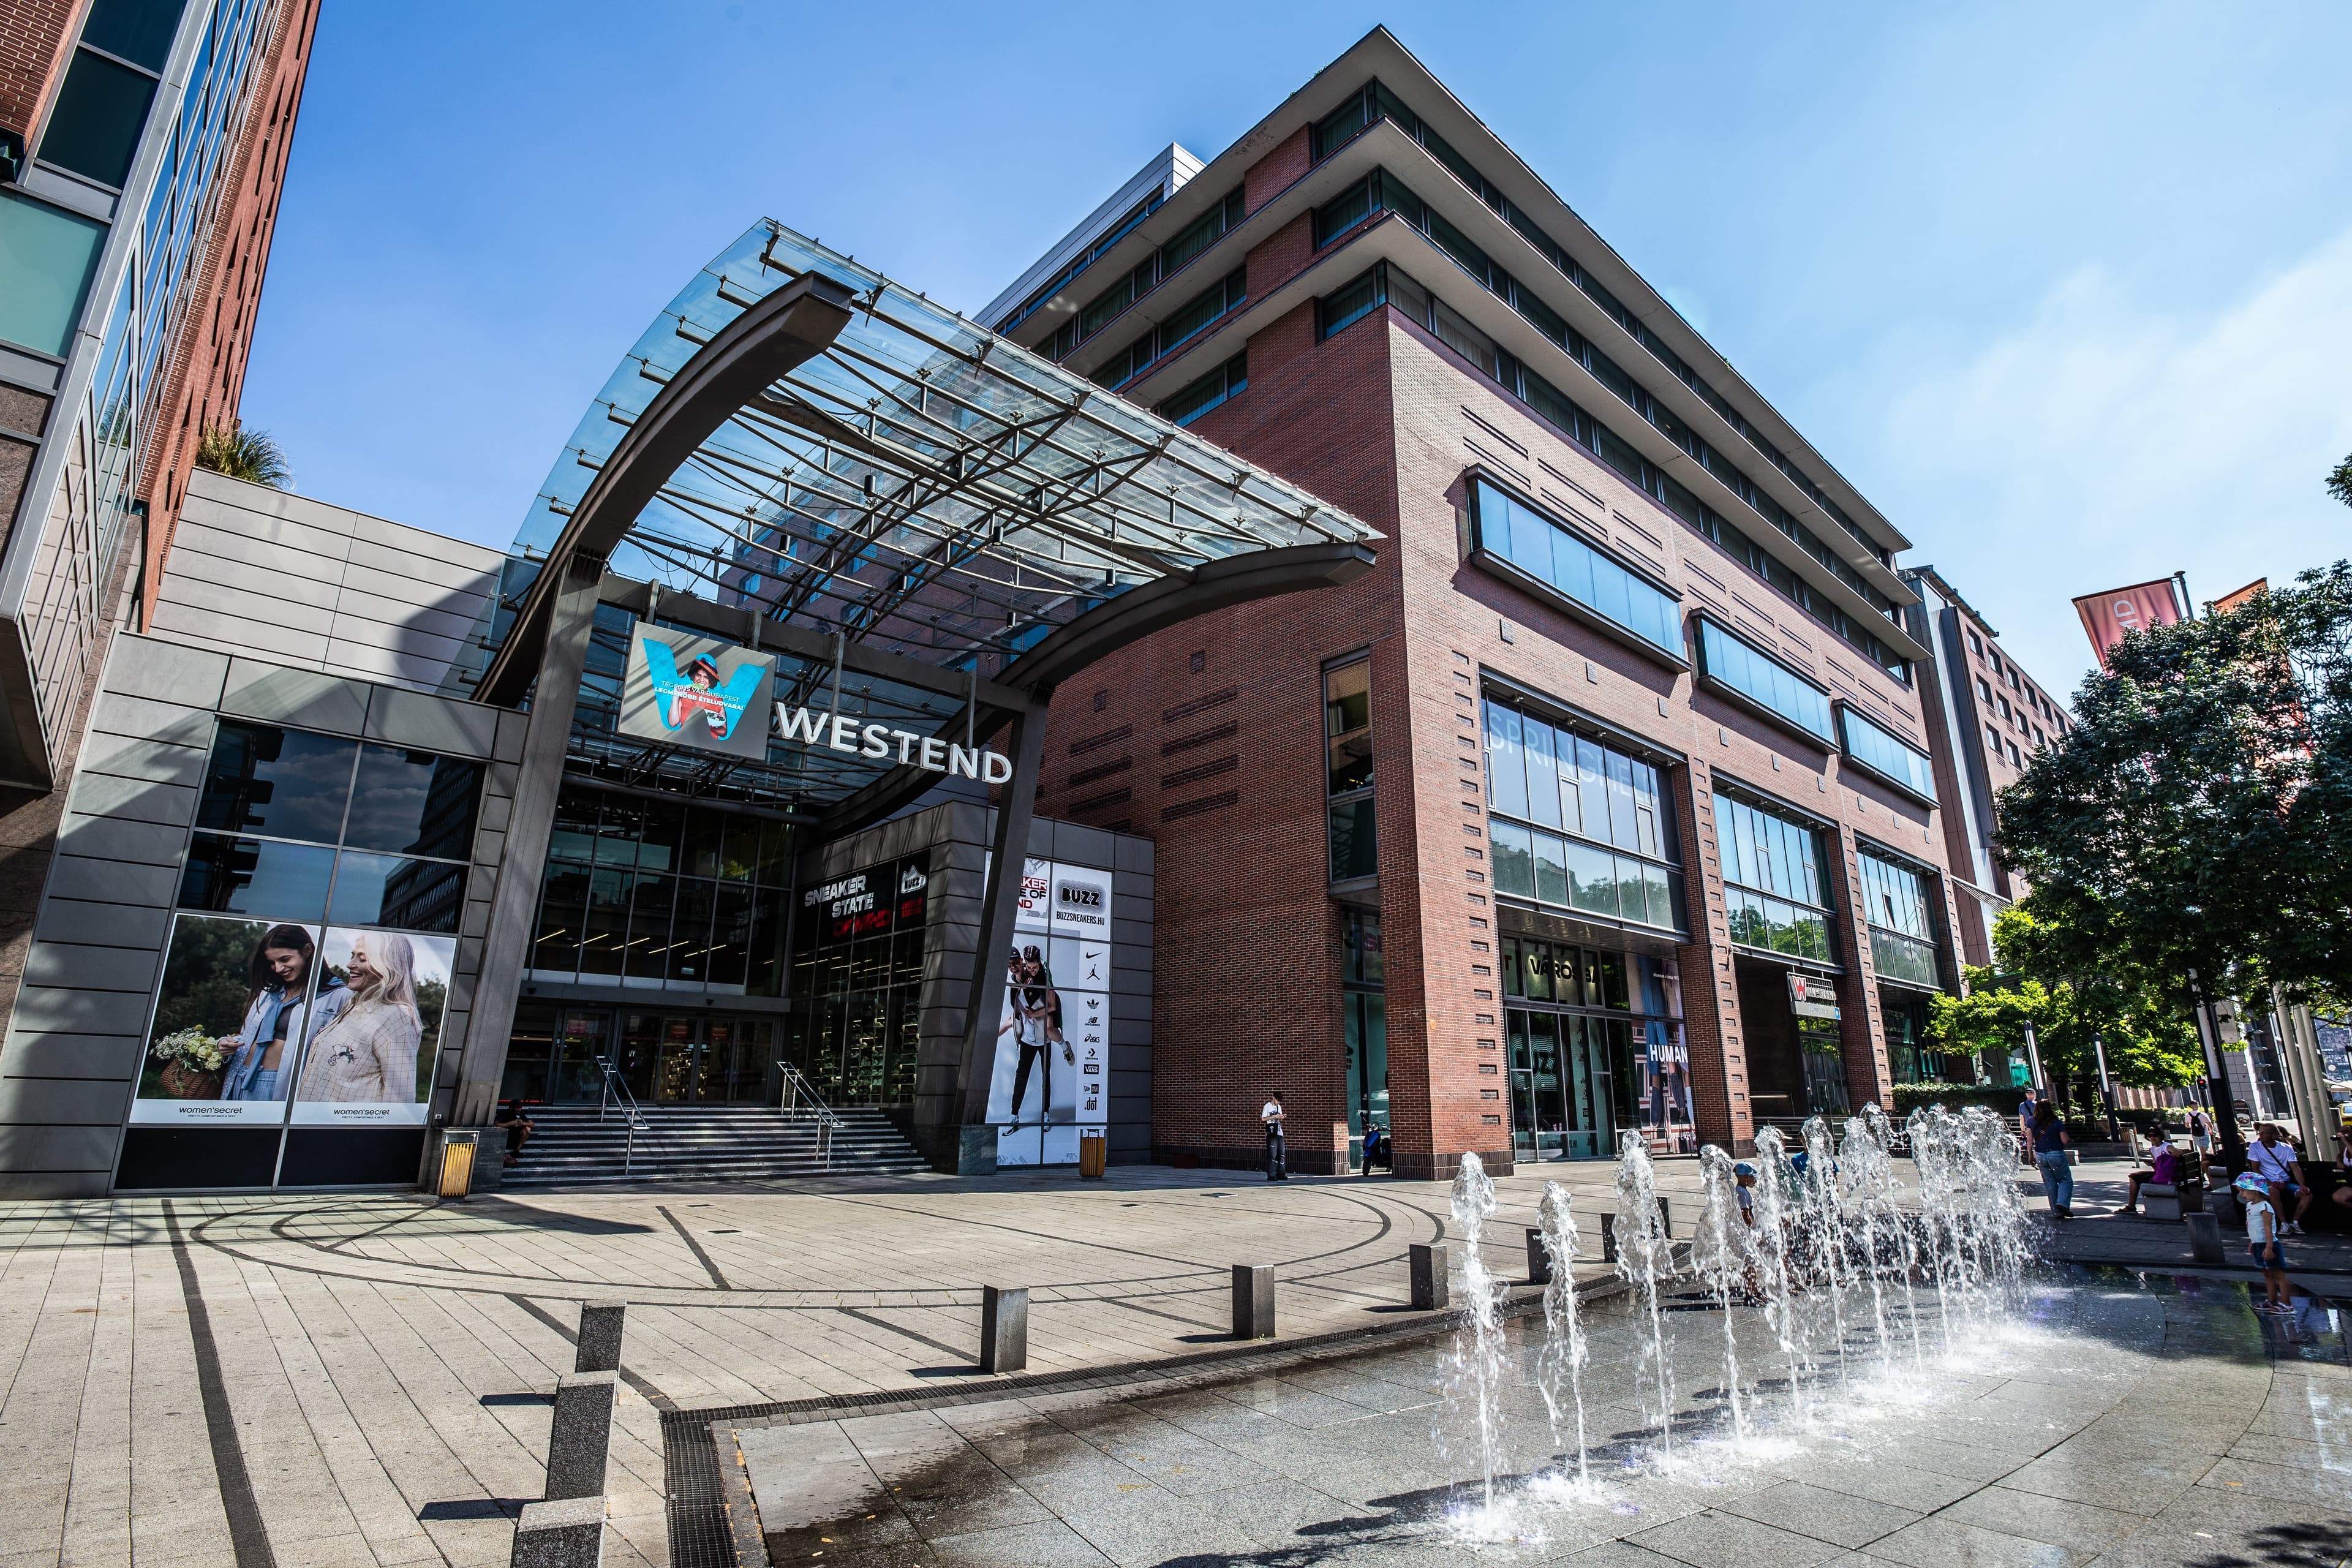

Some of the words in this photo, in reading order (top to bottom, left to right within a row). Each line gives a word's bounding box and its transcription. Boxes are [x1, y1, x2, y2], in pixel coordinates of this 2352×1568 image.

[692, 685, 705, 695] VÁR
[706, 691, 740, 703] BUDAPEST
[775, 701, 1012, 784] WESTEND
[804, 875, 867, 907] SNEAKER
[1061, 888, 1100, 907] BUZZ
[832, 892, 874, 918] STATE
[1056, 910, 1105, 926] BUZZSNEAKERS.HU
[1649, 1044, 1689, 1063] HUMAN
